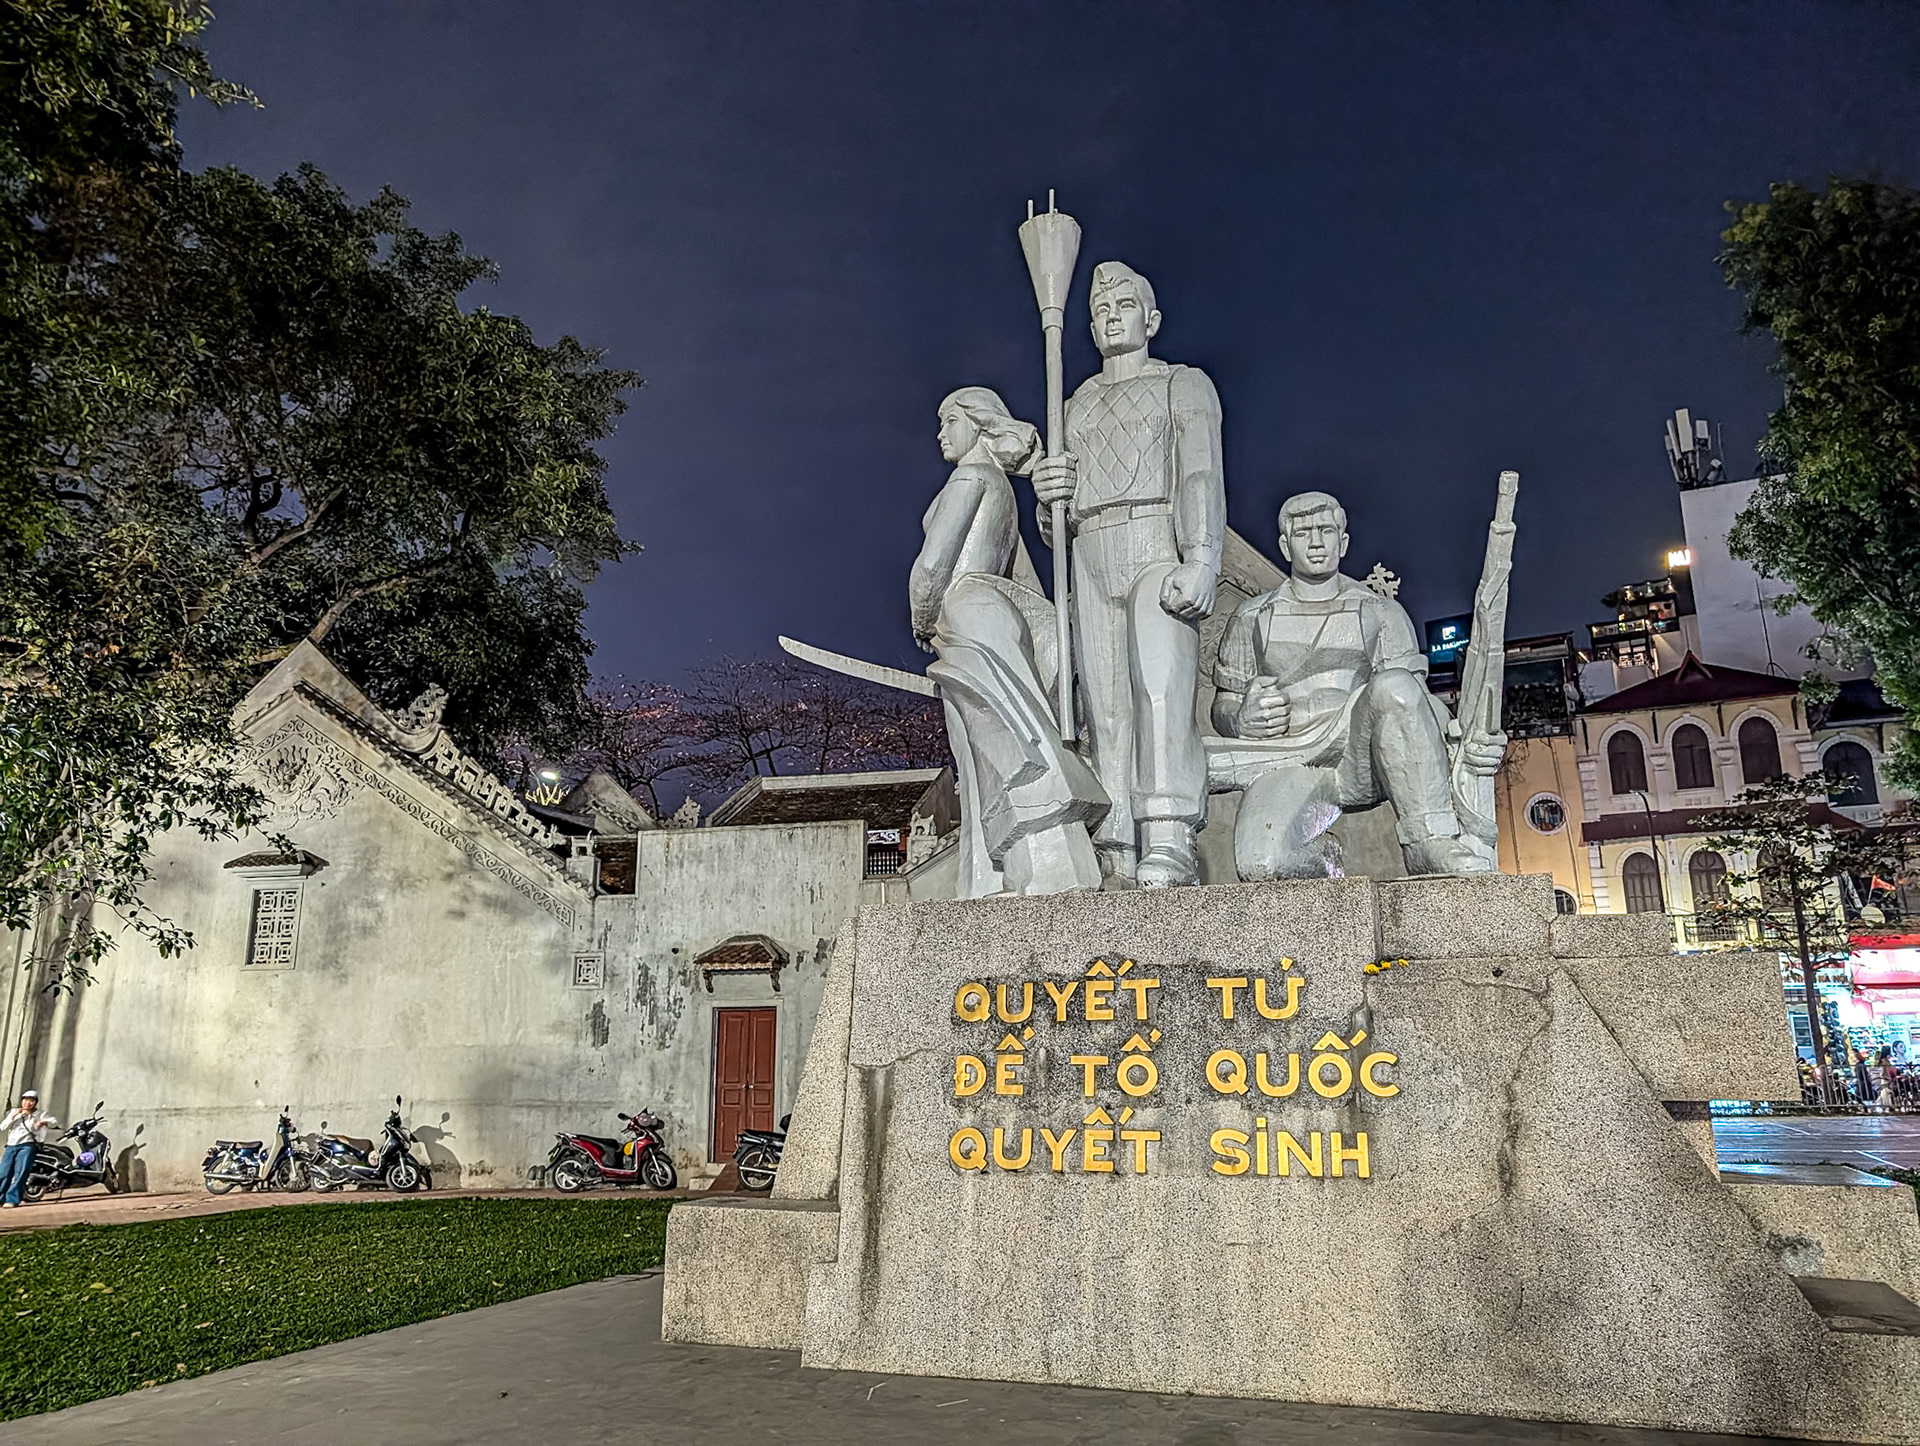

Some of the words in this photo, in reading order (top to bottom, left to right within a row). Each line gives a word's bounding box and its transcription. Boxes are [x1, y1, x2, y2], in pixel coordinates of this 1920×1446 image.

[954, 959, 1161, 1023] QUYẾT
[1206, 956, 1306, 1021] TỬ
[1205, 1029, 1401, 1098] QUỐC
[949, 1106, 1161, 1174] QUYẾT
